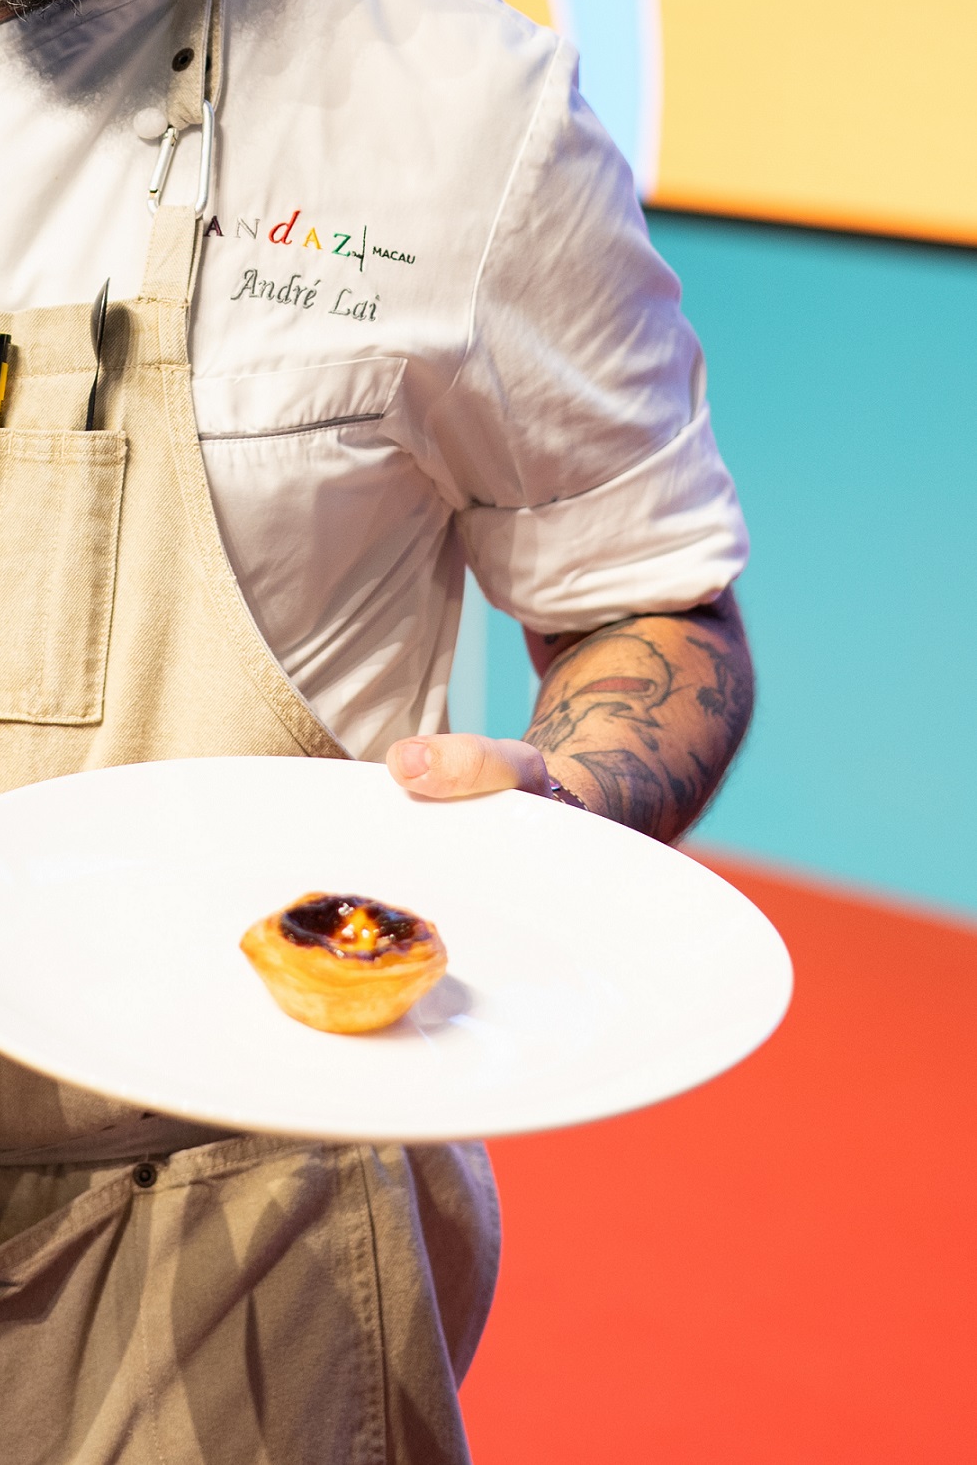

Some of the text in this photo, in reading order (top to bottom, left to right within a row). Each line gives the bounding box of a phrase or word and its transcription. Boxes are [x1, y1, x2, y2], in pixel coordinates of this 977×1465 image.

[372, 245, 416, 265] MACAU
[230, 268, 381, 322] André Lai
